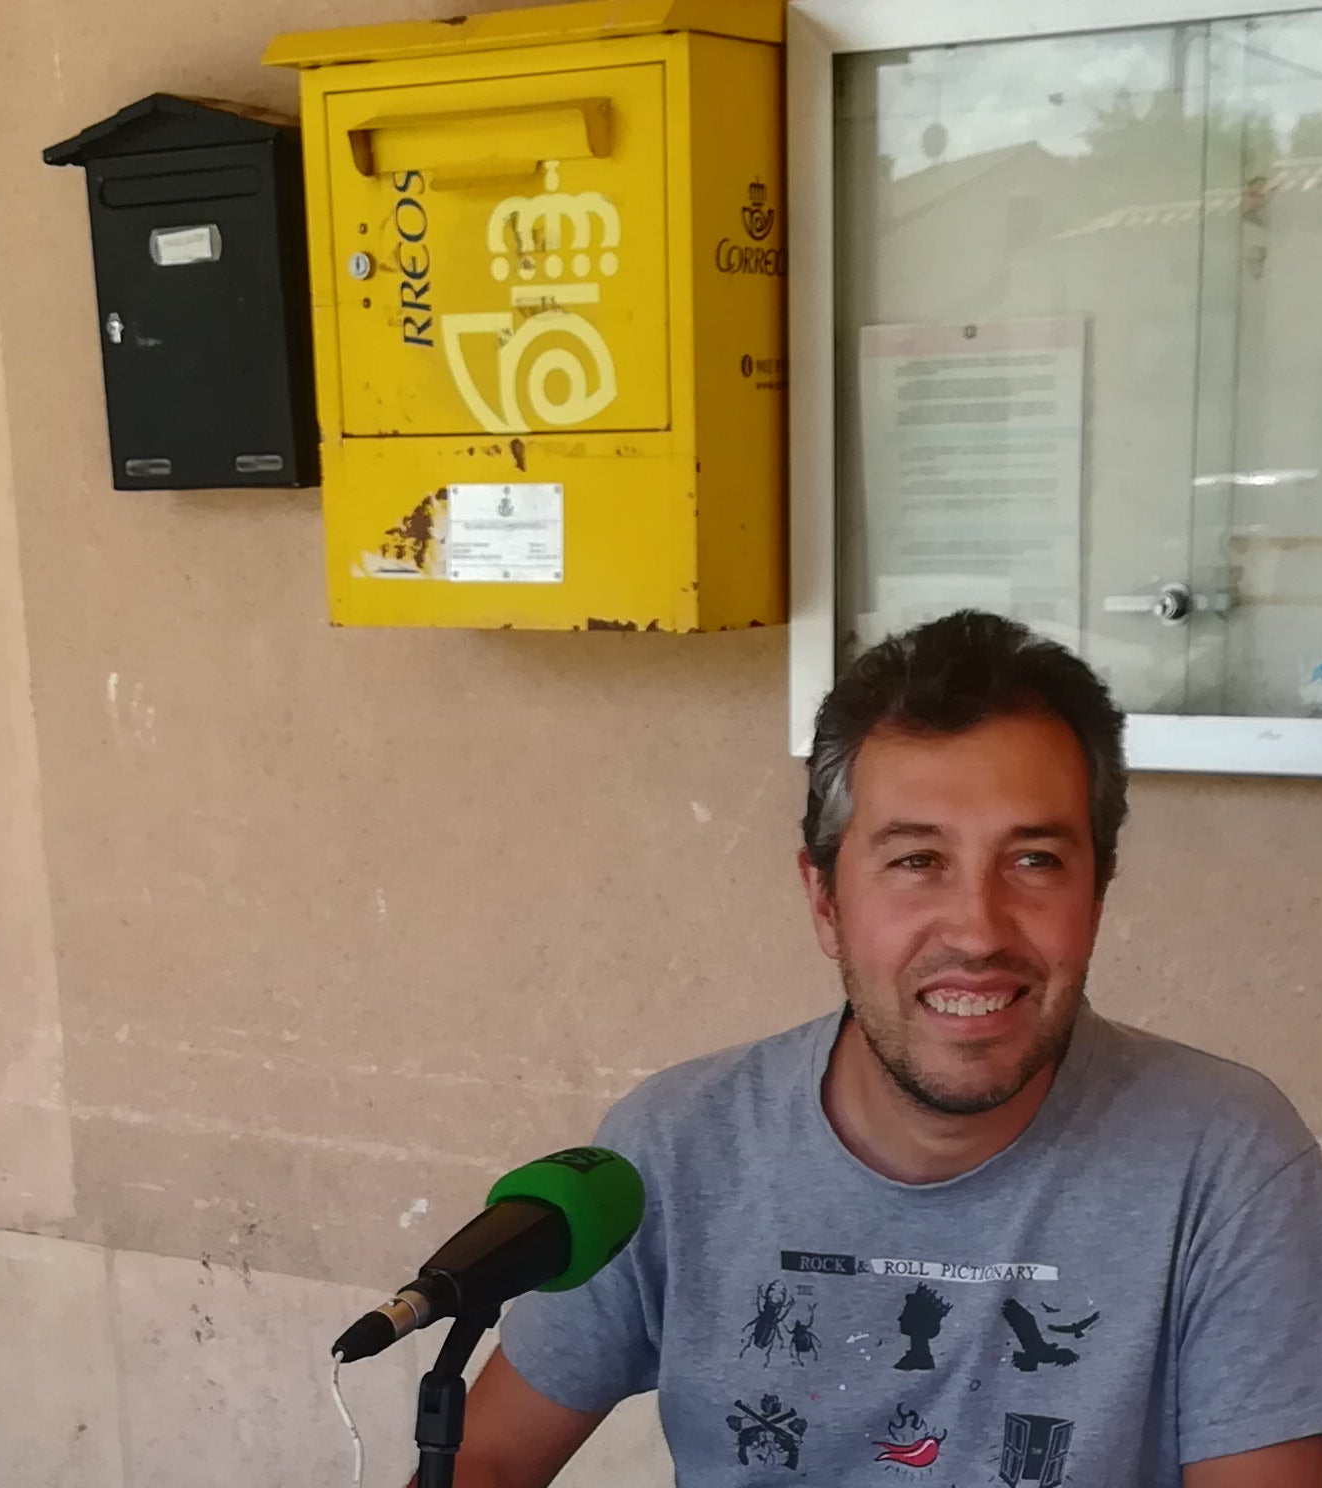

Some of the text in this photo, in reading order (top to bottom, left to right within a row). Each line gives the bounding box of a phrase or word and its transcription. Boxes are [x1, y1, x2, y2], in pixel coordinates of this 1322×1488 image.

[799, 1254, 1039, 1282] ROCK & ROLL PICTIONARY
